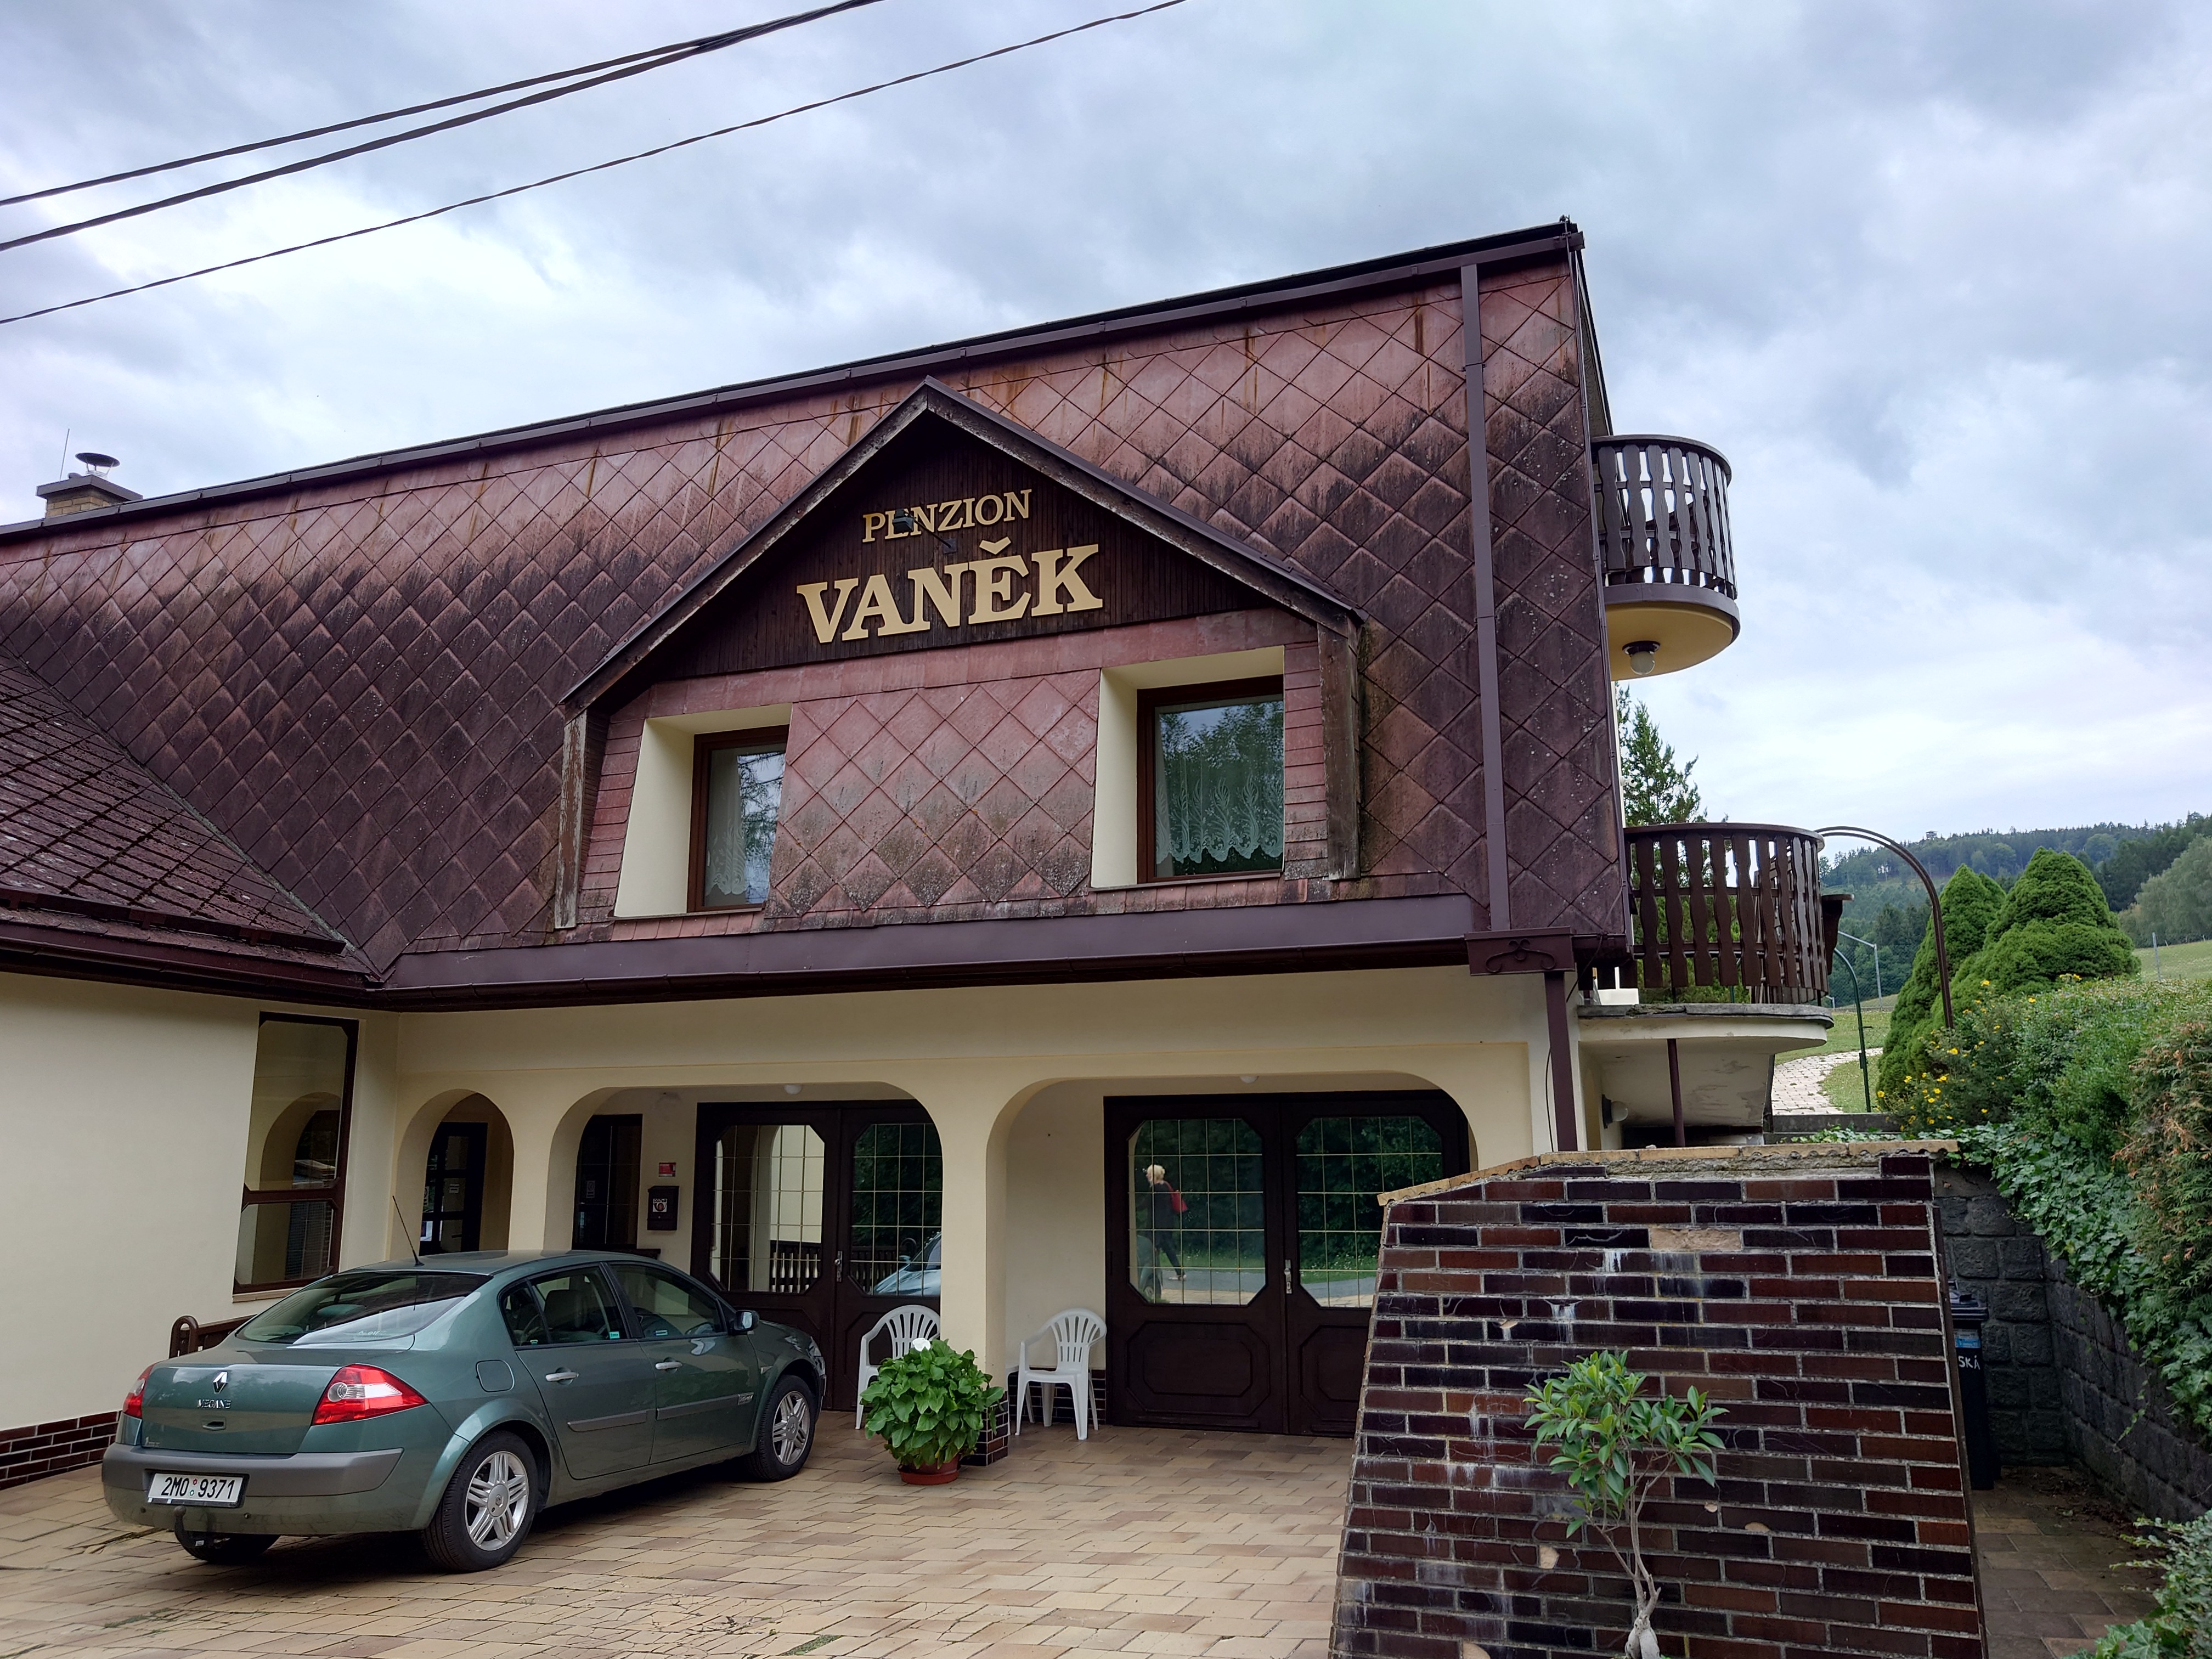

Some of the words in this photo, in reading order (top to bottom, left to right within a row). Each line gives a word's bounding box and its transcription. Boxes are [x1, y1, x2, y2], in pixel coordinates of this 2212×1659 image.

[862, 489, 1032, 543] PENZION
[797, 537, 1103, 643] VANĚK
[198, 1479, 235, 1499] 9371
